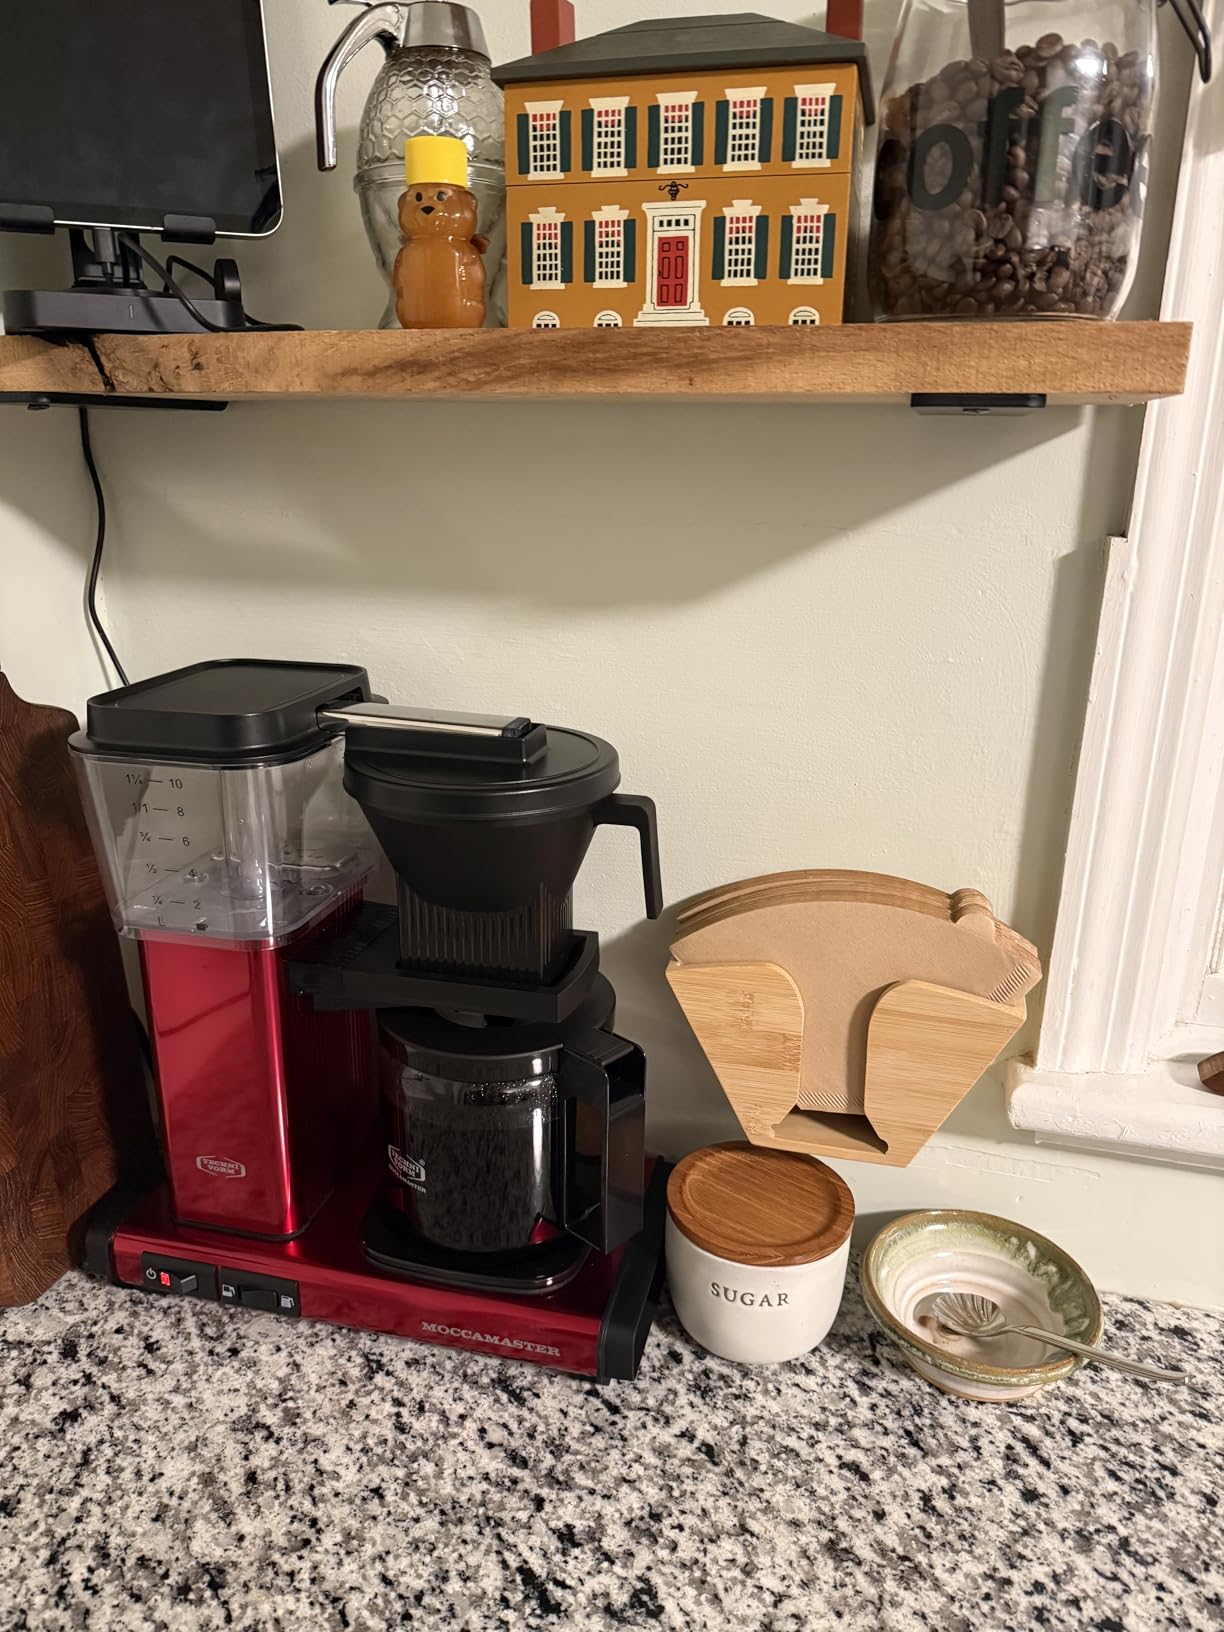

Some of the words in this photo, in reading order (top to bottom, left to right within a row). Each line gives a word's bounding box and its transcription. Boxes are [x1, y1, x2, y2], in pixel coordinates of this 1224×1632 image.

[169, 778, 183, 789] 10
[177, 806, 184, 817] 8
[182, 836, 190, 846] 6
[188, 868, 197, 878] 4
[193, 900, 201, 910] 2
[202, 1158, 240, 1170] TECHNI
[391, 1149, 420, 1173] TECHNI
[207, 1164, 236, 1174] VORM
[393, 1157, 416, 1178] VORM
[710, 1282, 790, 1307] SUGAR
[421, 1321, 561, 1357] MOCCAMASTER
